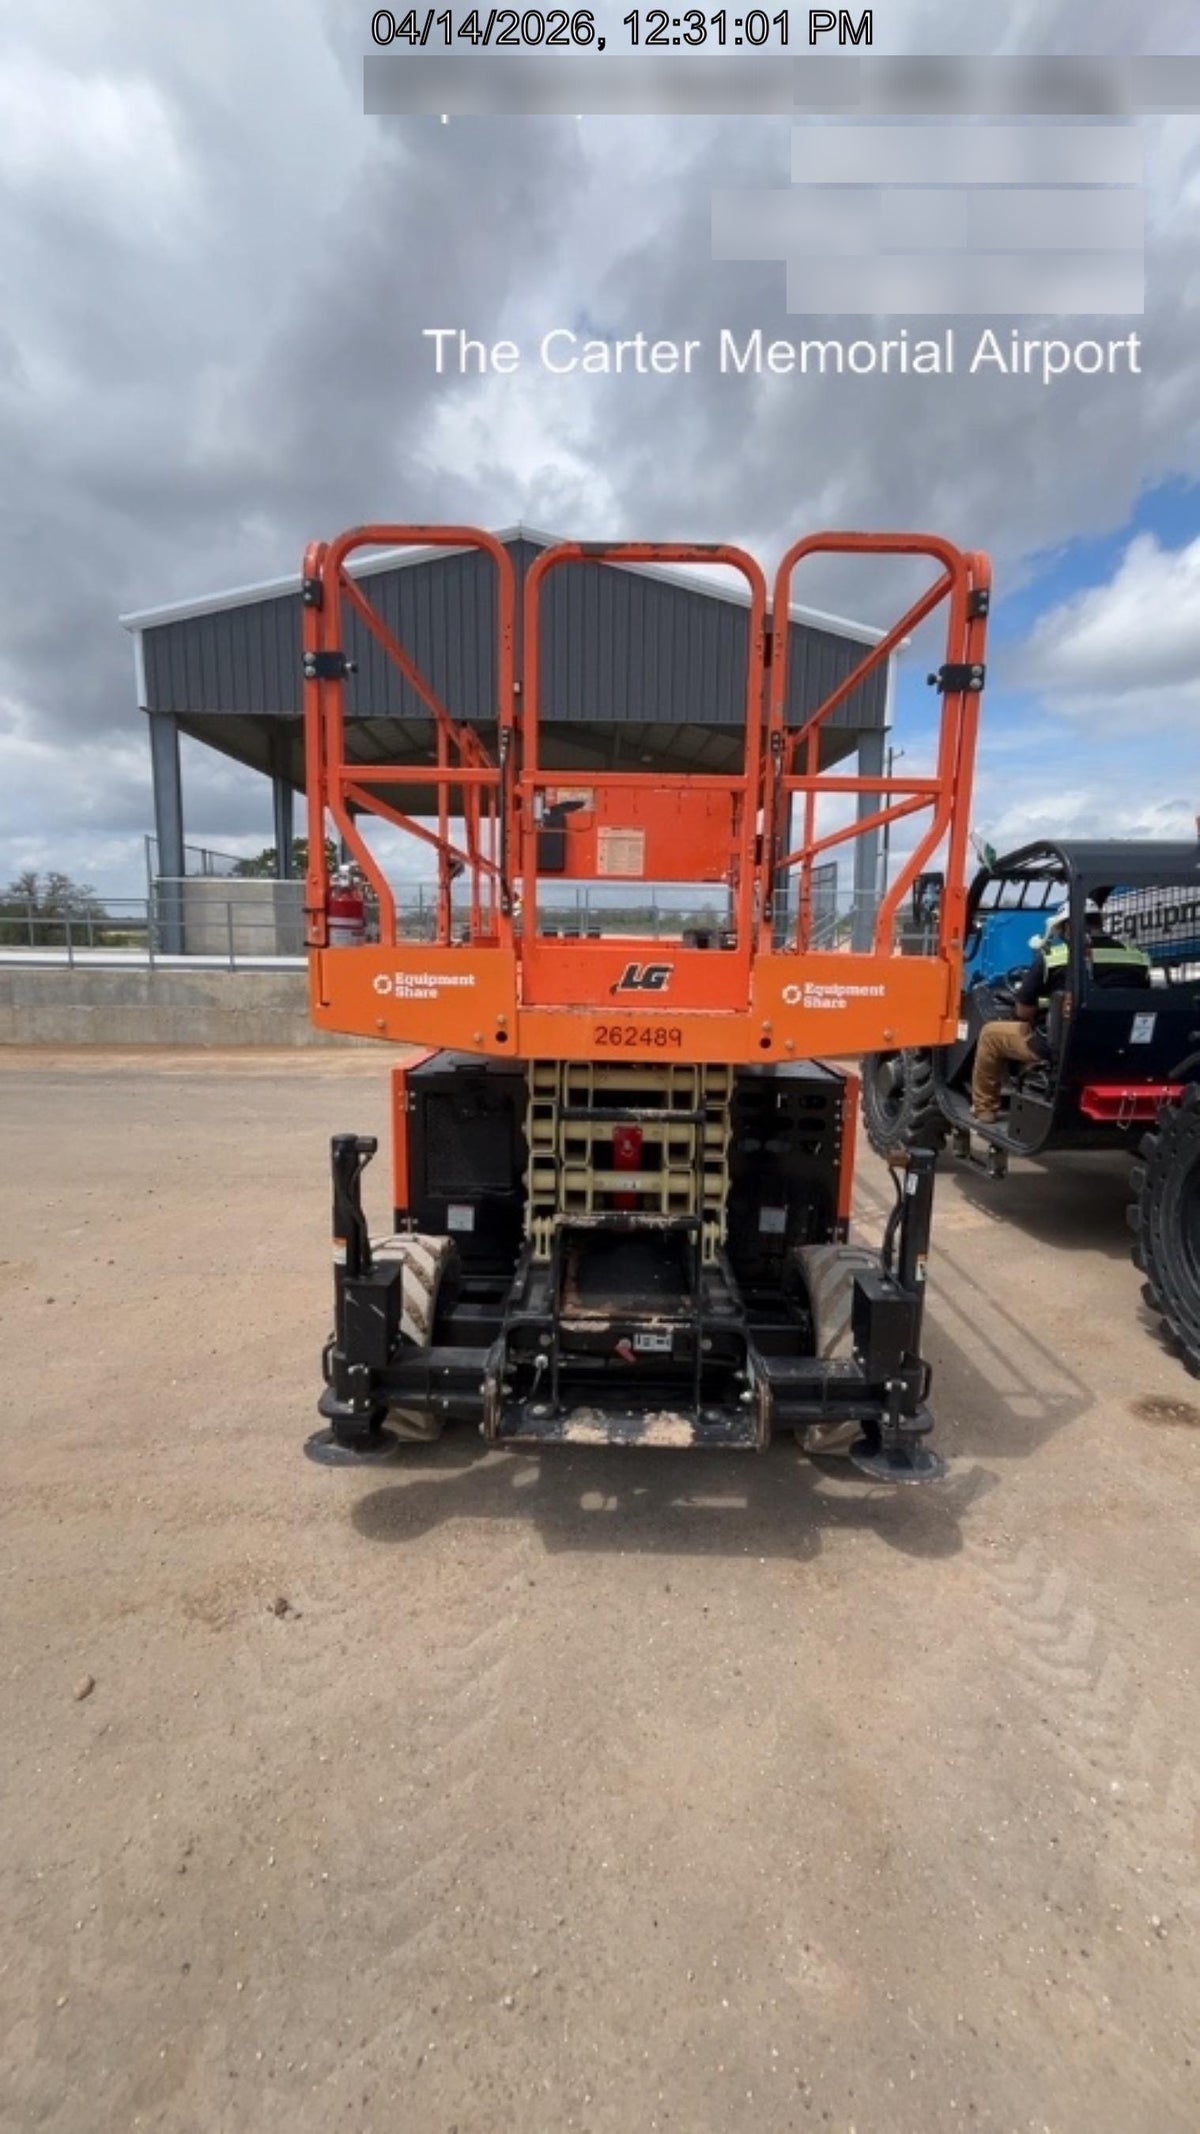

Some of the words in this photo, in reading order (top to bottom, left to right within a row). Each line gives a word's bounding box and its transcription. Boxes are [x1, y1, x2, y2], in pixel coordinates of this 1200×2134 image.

[394, 972, 475, 987] Equipment
[394, 985, 439, 999] Share
[804, 982, 886, 997] Equipment
[803, 995, 847, 1009] Share
[594, 1025, 682, 1048] 262489
